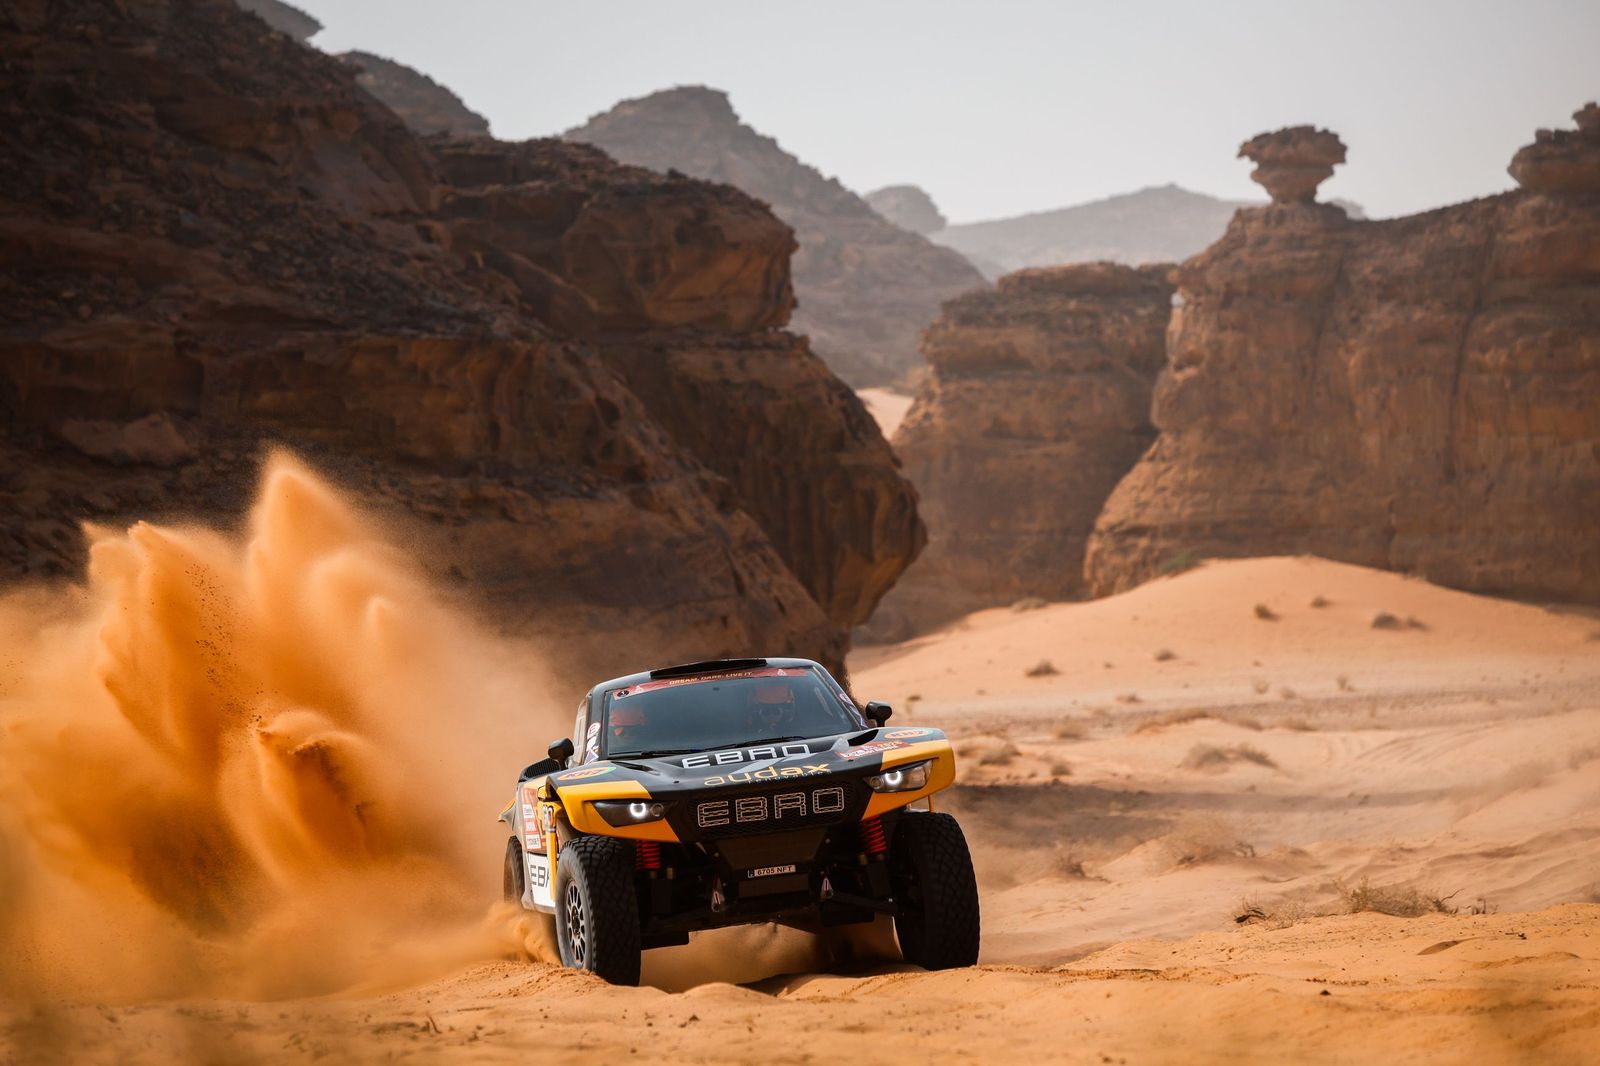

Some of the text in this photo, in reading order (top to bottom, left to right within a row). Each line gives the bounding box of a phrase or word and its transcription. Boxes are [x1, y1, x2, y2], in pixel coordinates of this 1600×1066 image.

[681, 744, 811, 769] EBRO
[703, 763, 831, 786] audax
[697, 786, 845, 828] EBRO
[757, 868, 775, 876] 6705
